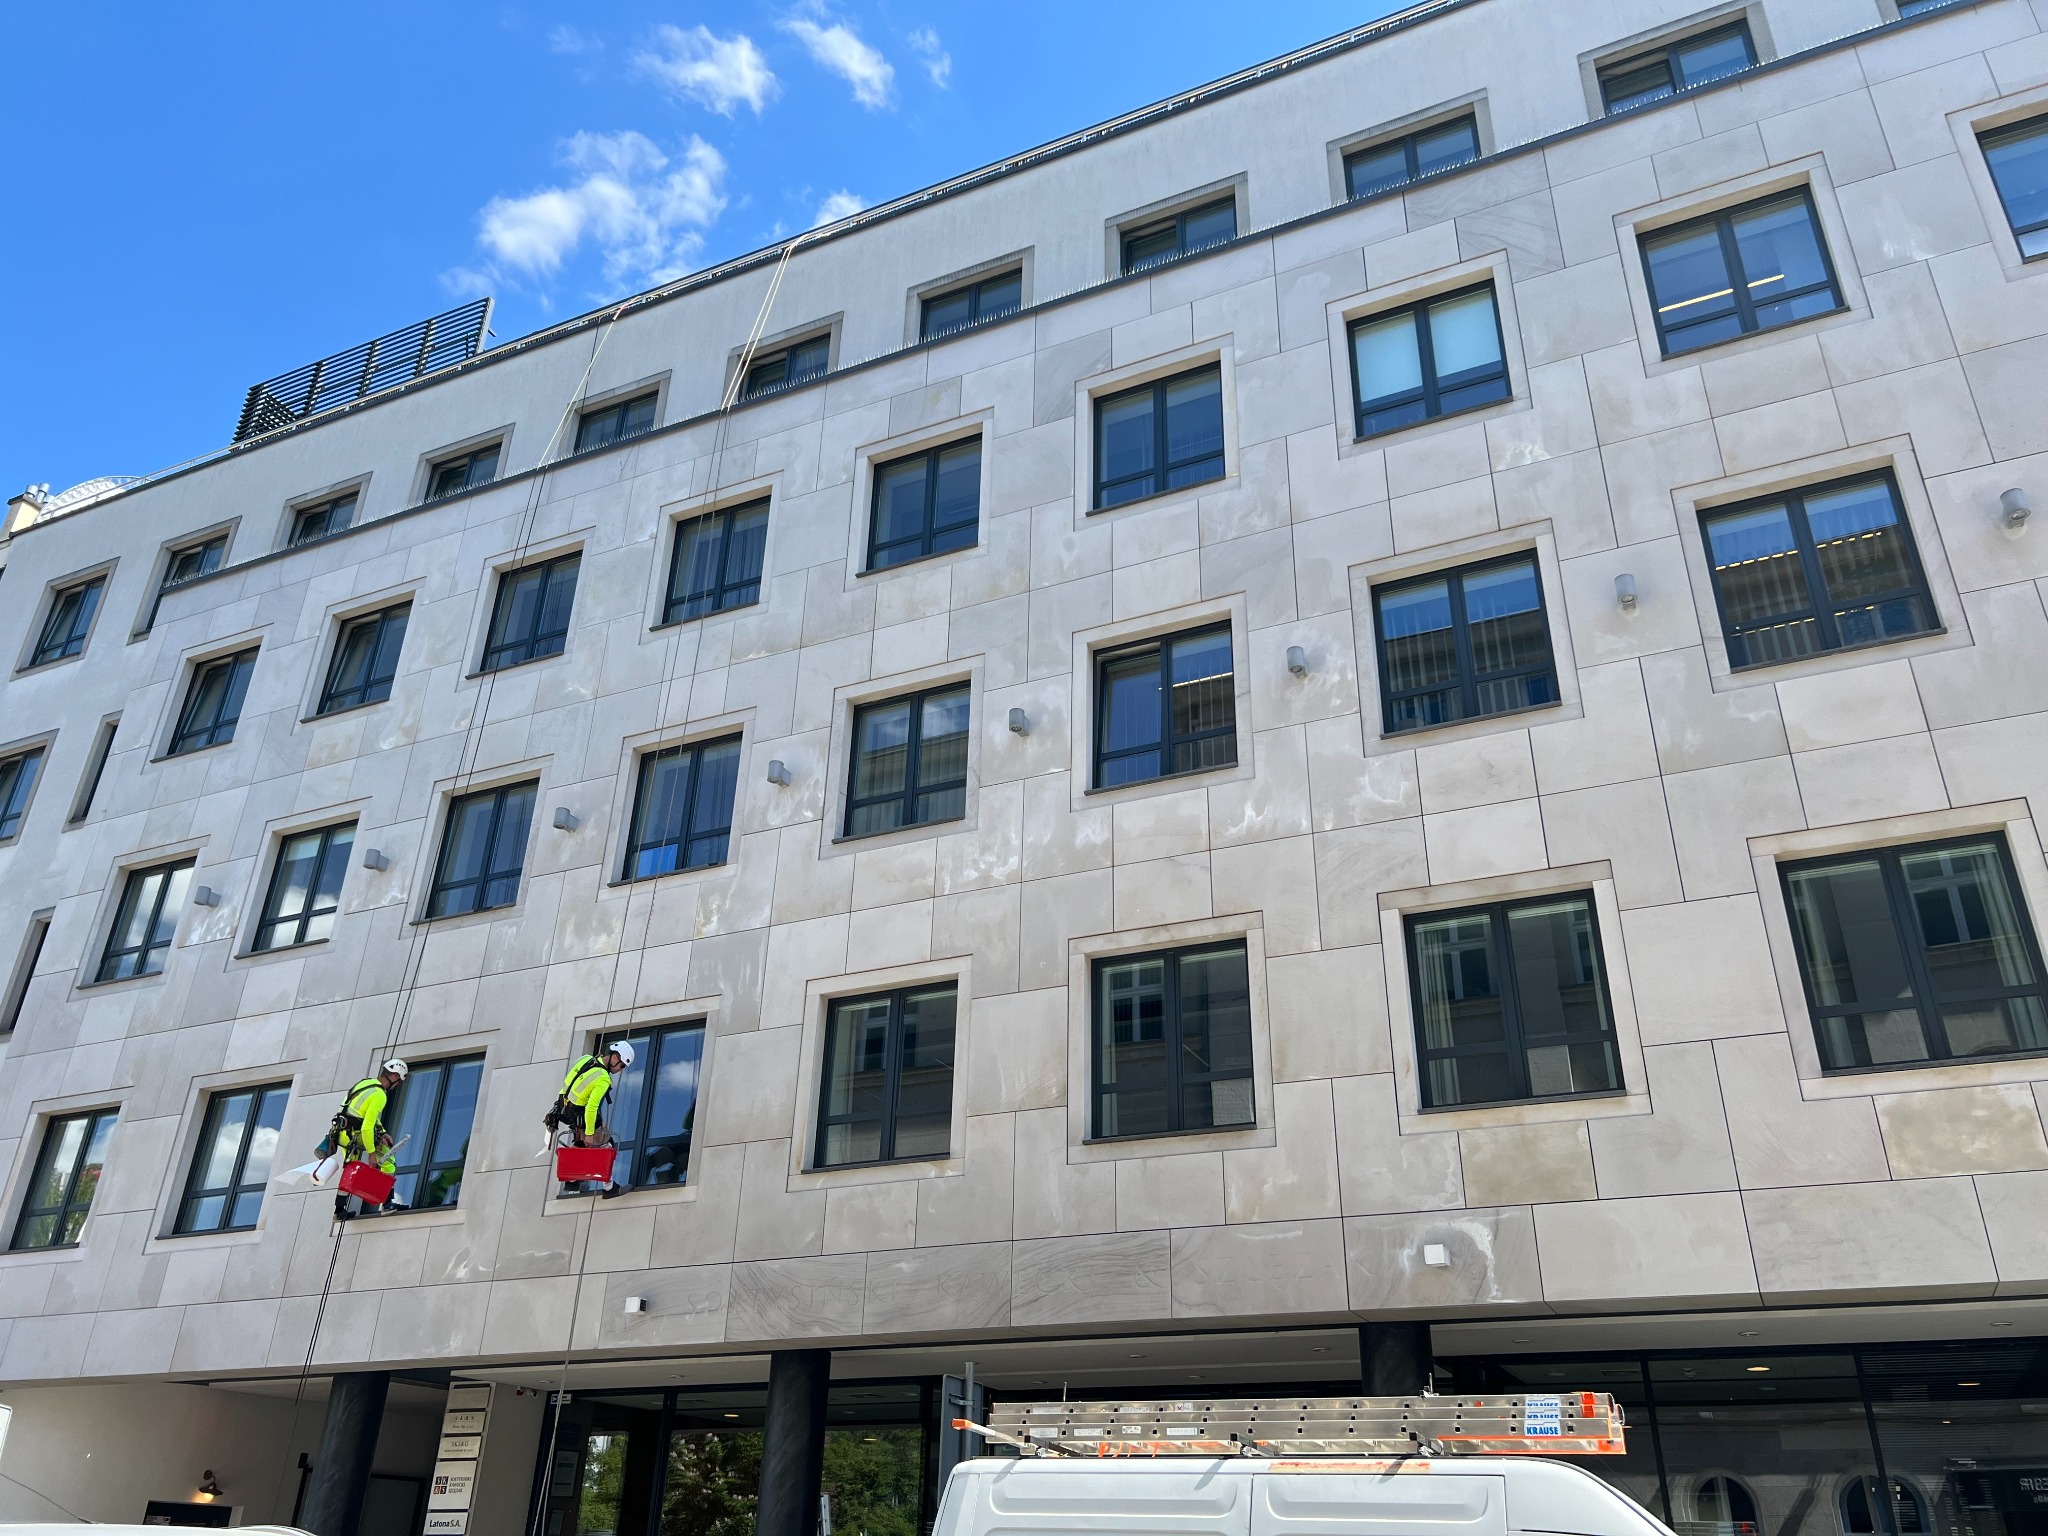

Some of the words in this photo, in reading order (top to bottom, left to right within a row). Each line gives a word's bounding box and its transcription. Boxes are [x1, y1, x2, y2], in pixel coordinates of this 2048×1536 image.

[936, 1265, 1097, 1302] KAWECKI
[1133, 1260, 1162, 1290] &
[1526, 1427, 1558, 1435] KRAUSE
